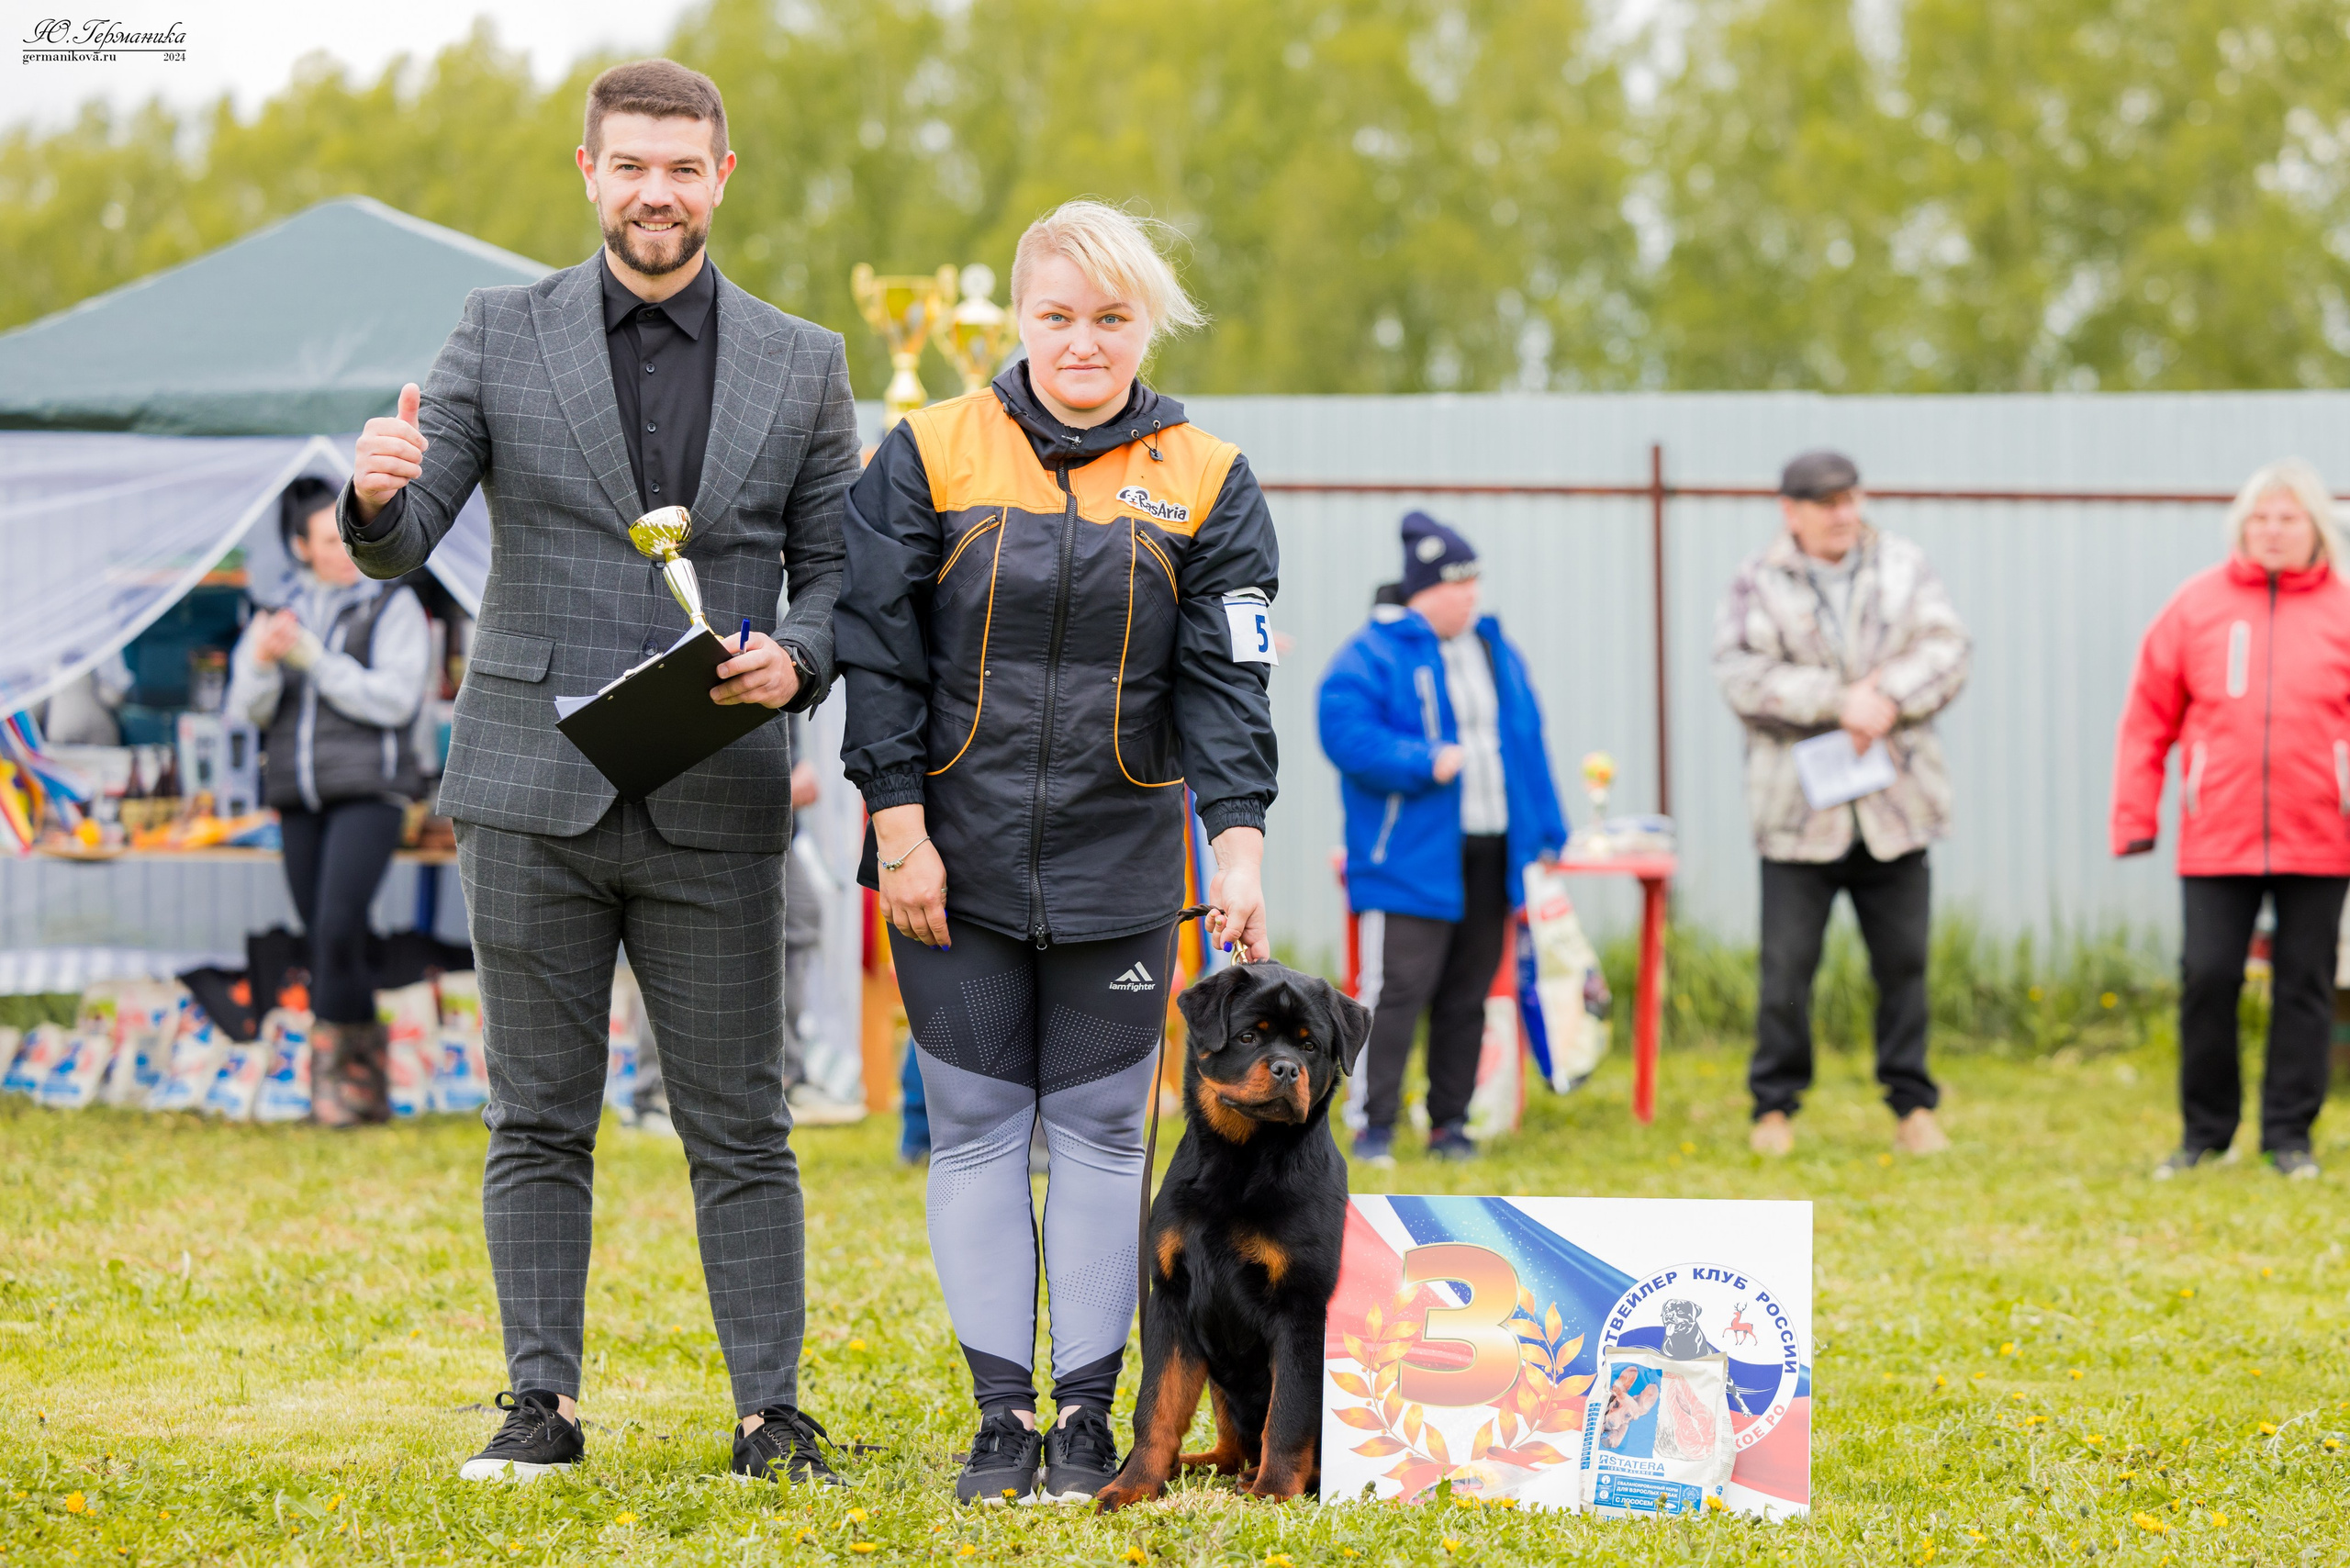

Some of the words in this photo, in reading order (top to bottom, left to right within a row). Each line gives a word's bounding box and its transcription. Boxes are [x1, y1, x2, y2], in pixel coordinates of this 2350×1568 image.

[1255, 614, 1269, 653] 5
[1109, 981, 1156, 991] iamfighter
[1398, 1241, 1523, 1408] 3
[1602, 1271, 1678, 1367] ТВЕЙЛЕР
[1693, 1268, 1749, 1291] КЛУБ
[1755, 1291, 1797, 1374] РОССИИ
[1608, 1456, 1665, 1472] STATERA
[1617, 1481, 1665, 1490] СБАЛАНСИРОВАННЫЙ
[1628, 1487, 1660, 1496] ВЗРОСЛЫХ
[1620, 1497, 1653, 1506] ЛОСОСЕМ
